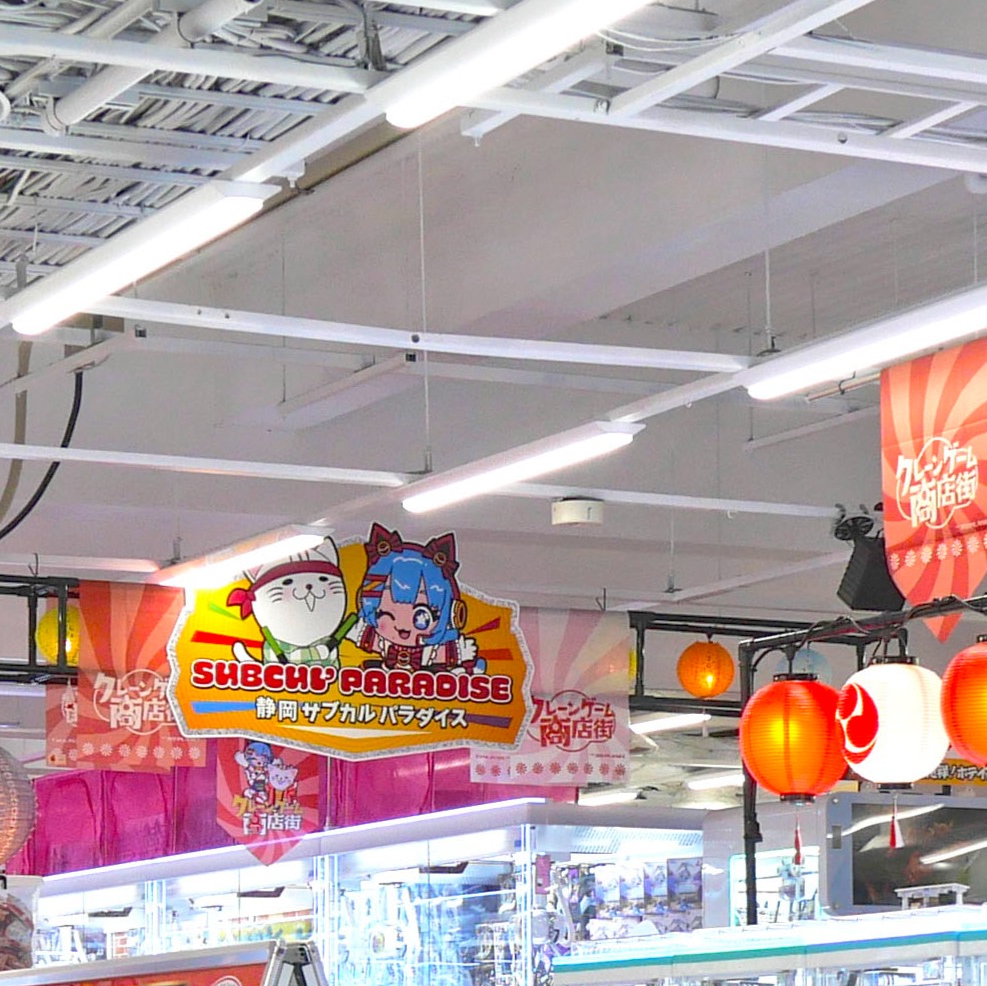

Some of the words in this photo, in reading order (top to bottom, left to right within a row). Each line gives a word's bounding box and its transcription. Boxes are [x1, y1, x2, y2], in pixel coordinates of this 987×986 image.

[896, 441, 978, 498] クレーンゲーム
[909, 470, 977, 528] 商店街
[340, 668, 511, 702] PARADISE
[540, 716, 613, 747] 商店街
[243, 811, 302, 836] 商店街
